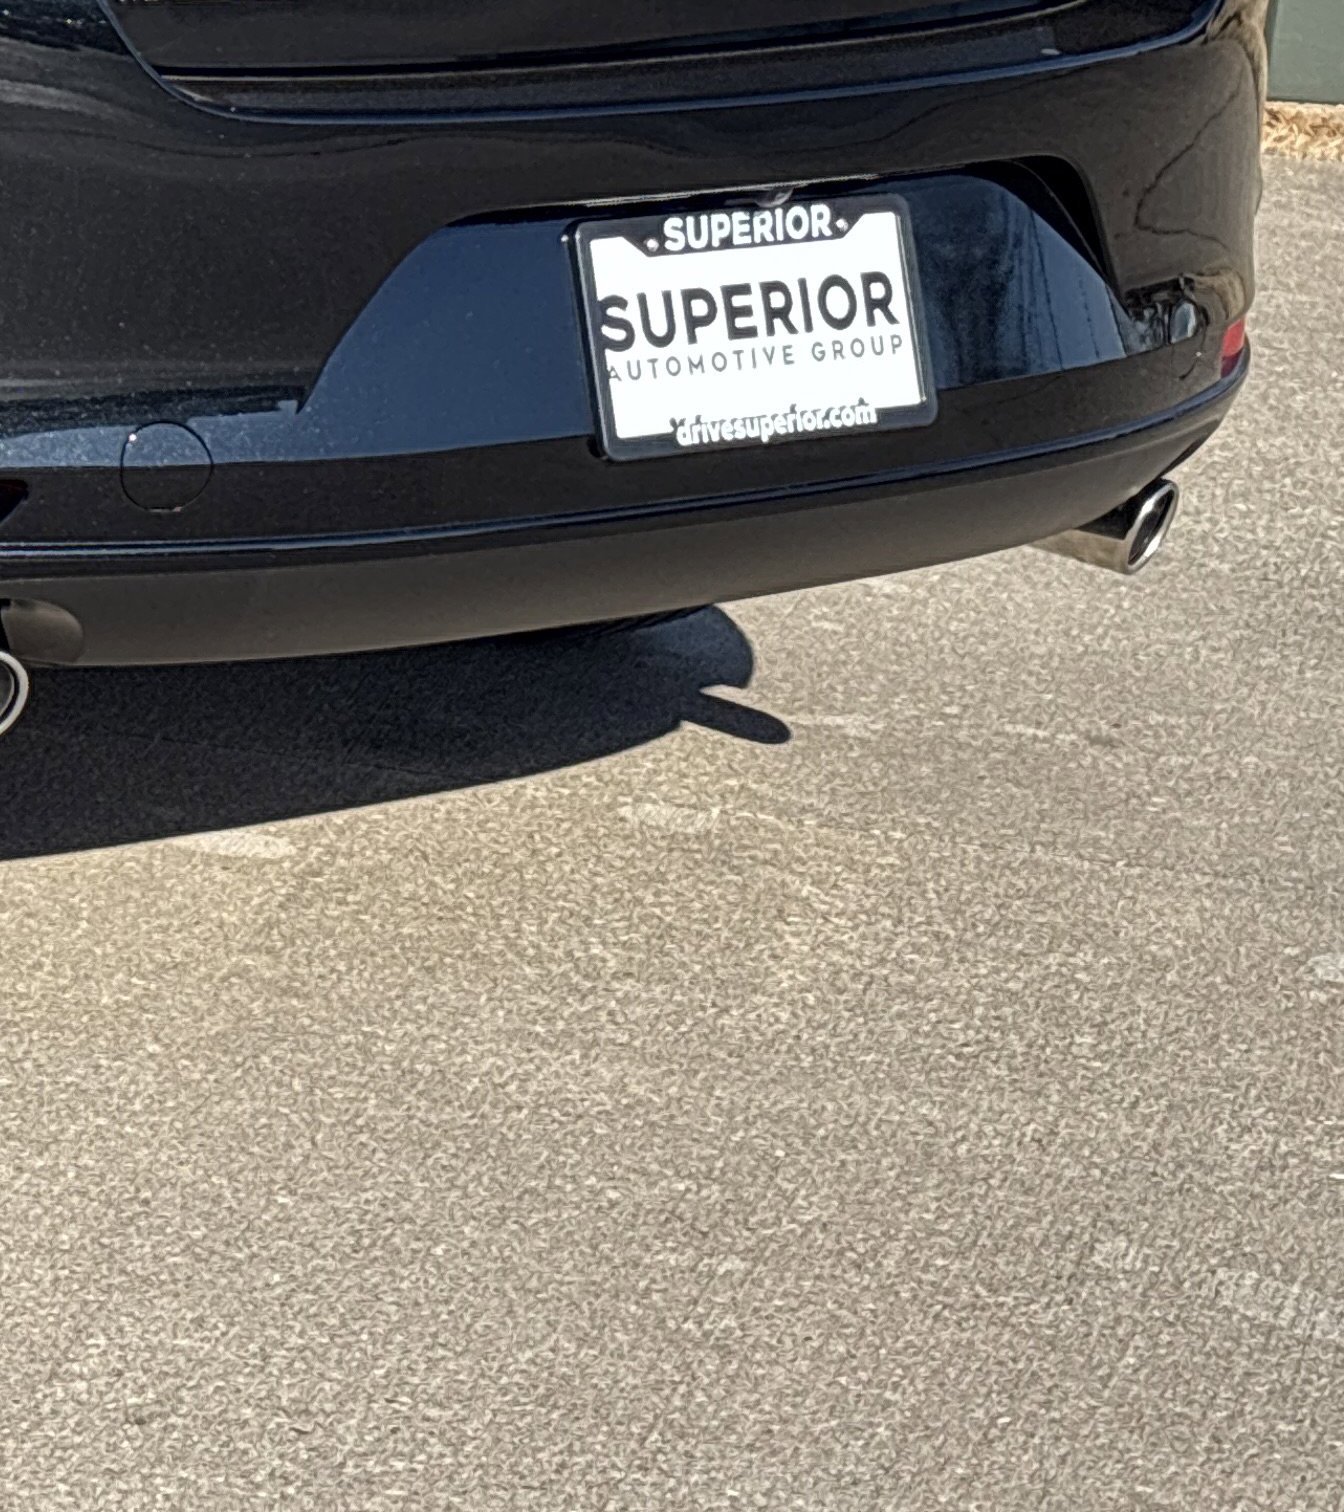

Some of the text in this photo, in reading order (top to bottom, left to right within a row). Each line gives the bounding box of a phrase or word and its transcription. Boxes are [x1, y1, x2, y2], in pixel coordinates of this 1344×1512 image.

[663, 203, 834, 252] SUPERIOR
[599, 271, 900, 352] SUPERIOR
[609, 334, 904, 382] AUTOMOTIVE GROUP
[676, 403, 878, 447] drivesuperior.com
